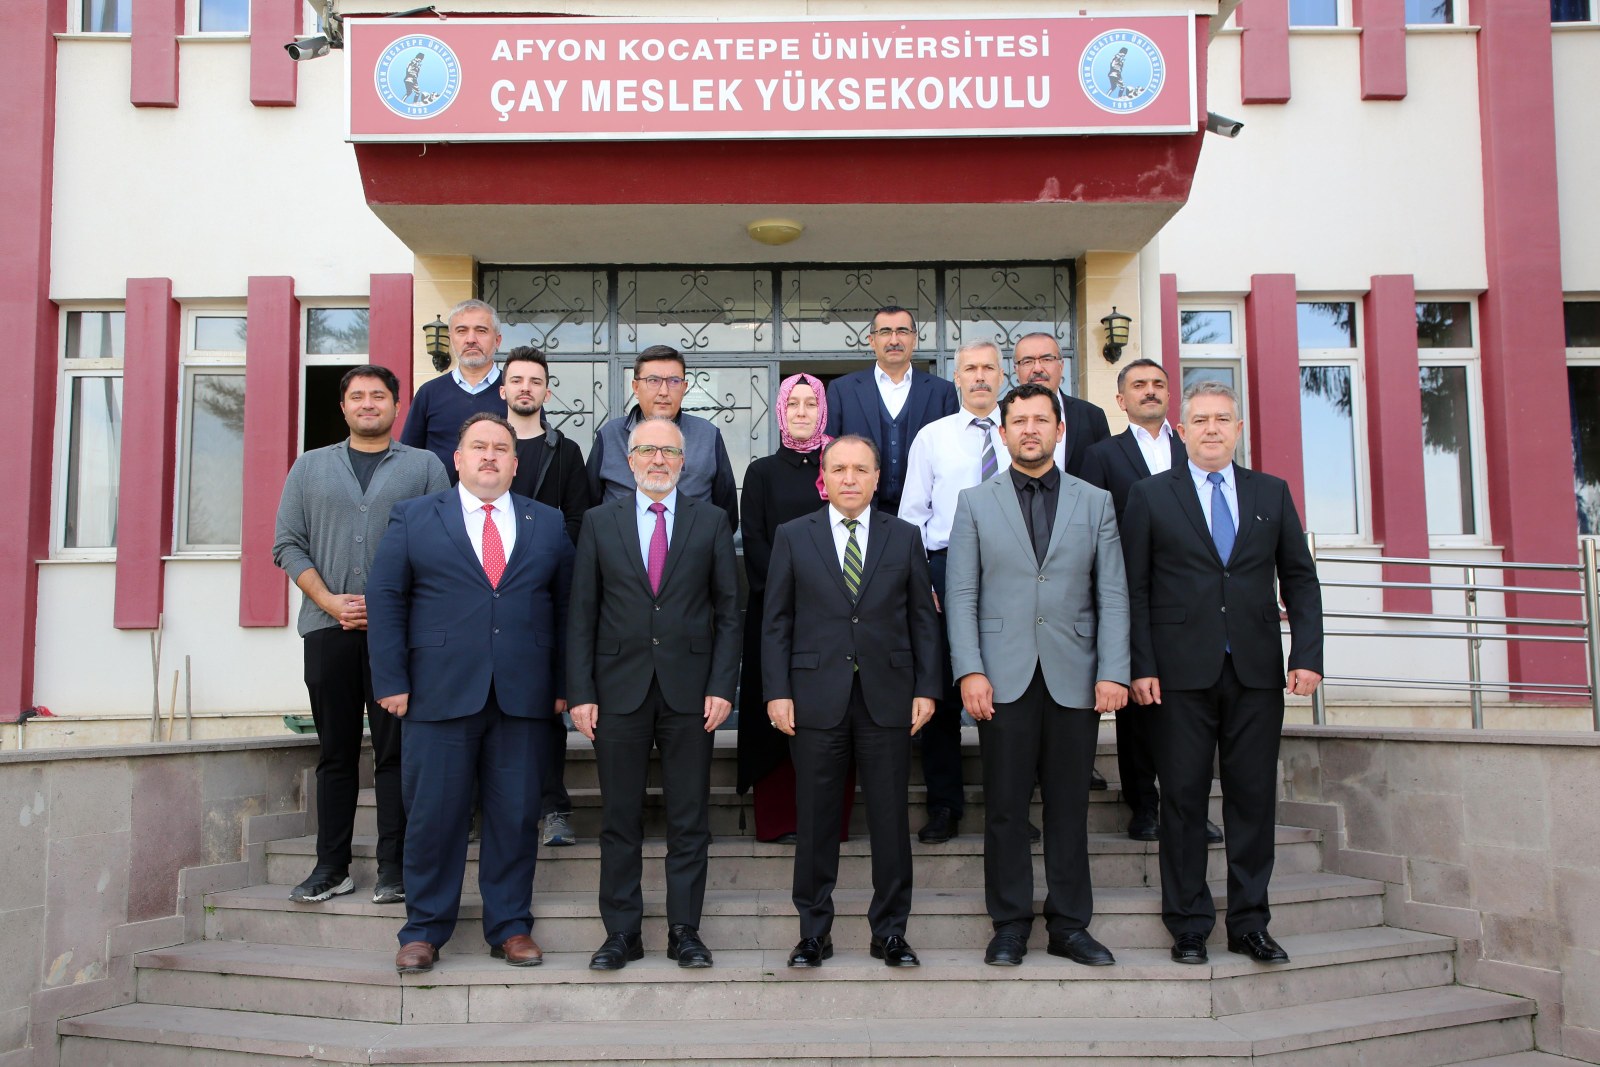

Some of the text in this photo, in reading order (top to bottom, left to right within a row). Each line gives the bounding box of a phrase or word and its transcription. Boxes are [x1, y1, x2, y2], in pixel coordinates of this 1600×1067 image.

[382, 39, 423, 67] KOCATEPE
[491, 29, 1050, 61] AFYON KOCATEPE ÜNİVERSİTESİ
[1088, 34, 1127, 62] KOCATEPE
[379, 71, 394, 100] AFYON
[1084, 66, 1098, 95] AFYON
[490, 70, 1050, 122] ÇAY MESLEK YÜKSEKOKULU
